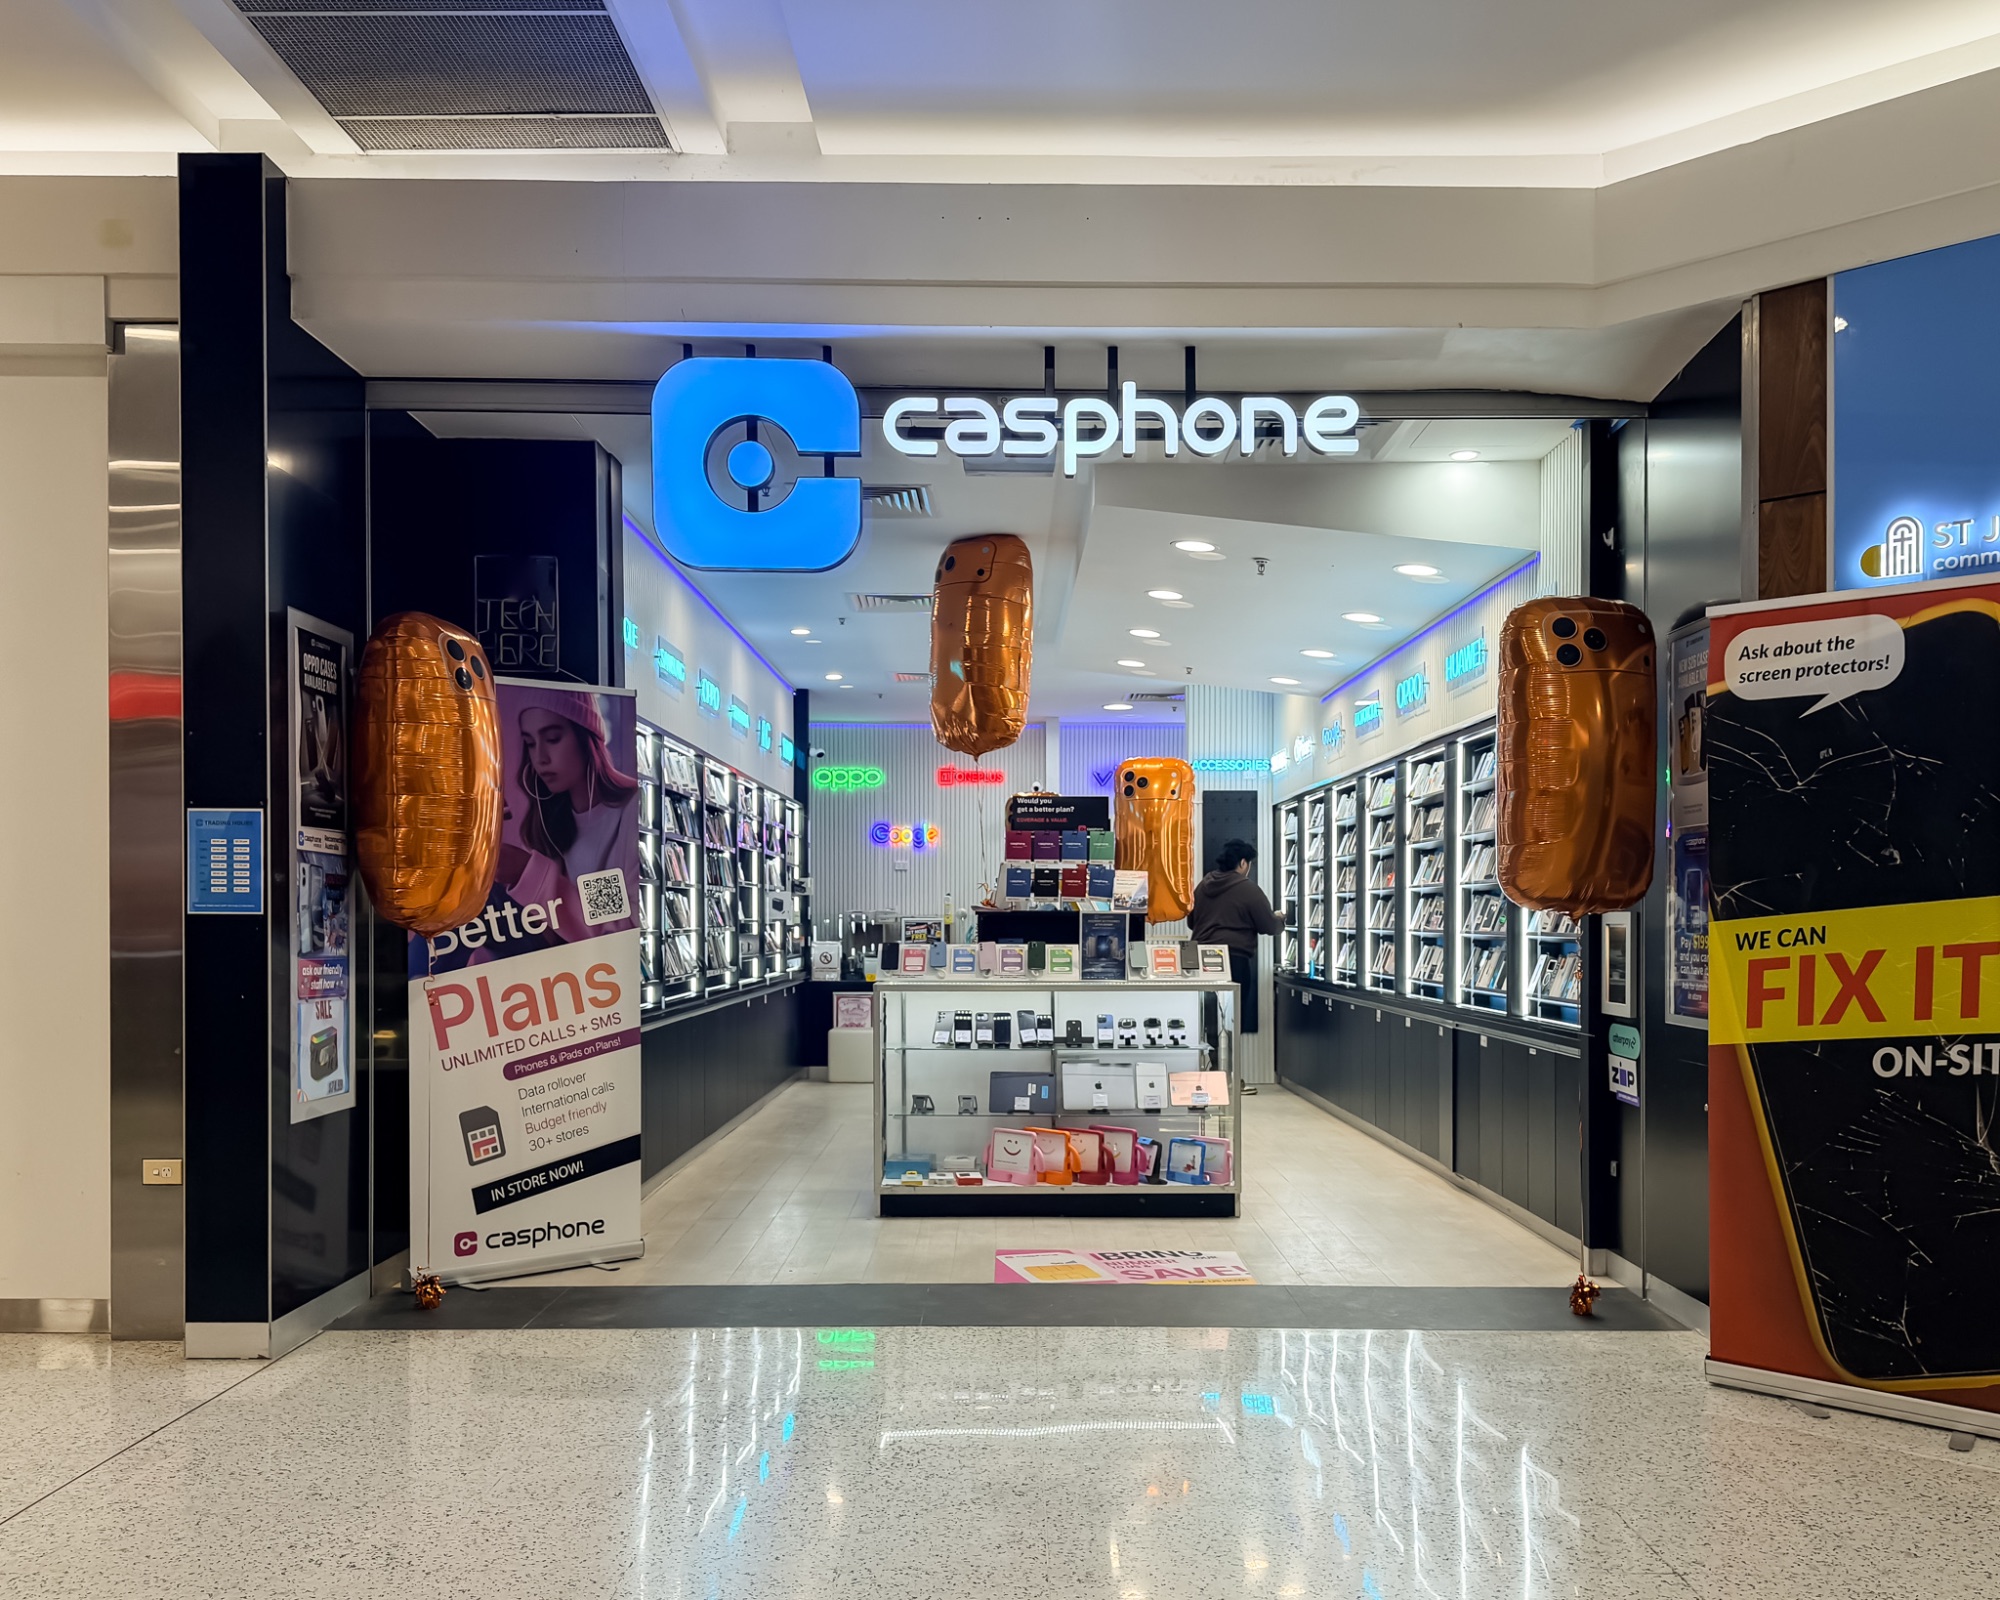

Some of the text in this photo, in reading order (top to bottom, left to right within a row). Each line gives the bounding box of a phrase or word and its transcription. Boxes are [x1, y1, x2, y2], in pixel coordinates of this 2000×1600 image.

[882, 380, 1360, 478] casphone
[1932, 519, 1974, 549] ST
[1932, 550, 2000, 571] comm
[1446, 638, 1485, 682] HUAWEI
[1738, 635, 1856, 661] Ask about the
[303, 653, 337, 680] OPPO CASES
[1738, 654, 1890, 684] screen protectors!
[1396, 672, 1422, 709] OPPO
[814, 767, 884, 791] oppo
[956, 771, 1005, 783] ONEPLUS
[1193, 760, 1270, 771] ACCESSORIES
[872, 821, 939, 849] Google
[1680, 936, 1691, 950] Pay
[1735, 925, 1826, 951] WE CAN
[302, 964, 343, 978] ask our friendly
[1680, 953, 1690, 961] and
[1690, 954, 1700, 963] you
[311, 979, 323, 990] staff
[1746, 941, 2000, 1029] FIX IT
[315, 1000, 332, 1020] SALE
[427, 963, 622, 1051] Plans
[441, 1012, 622, 1072] UNLIMITED CALLS + SMS
[514, 1036, 622, 1075] Phones & iPads on Plans!
[518, 1071, 587, 1101] Data rollover
[521, 1081, 616, 1117] International calls
[525, 1100, 608, 1135] Budget friendly
[528, 1124, 590, 1151] 30+ stores
[491, 1160, 585, 1202] IN STORE NOW!
[485, 1218, 606, 1249] casphone
[1098, 1250, 1203, 1261] BRING
[1104, 1259, 1179, 1267] NUMBER
[1120, 1265, 1251, 1280] SAVE!
